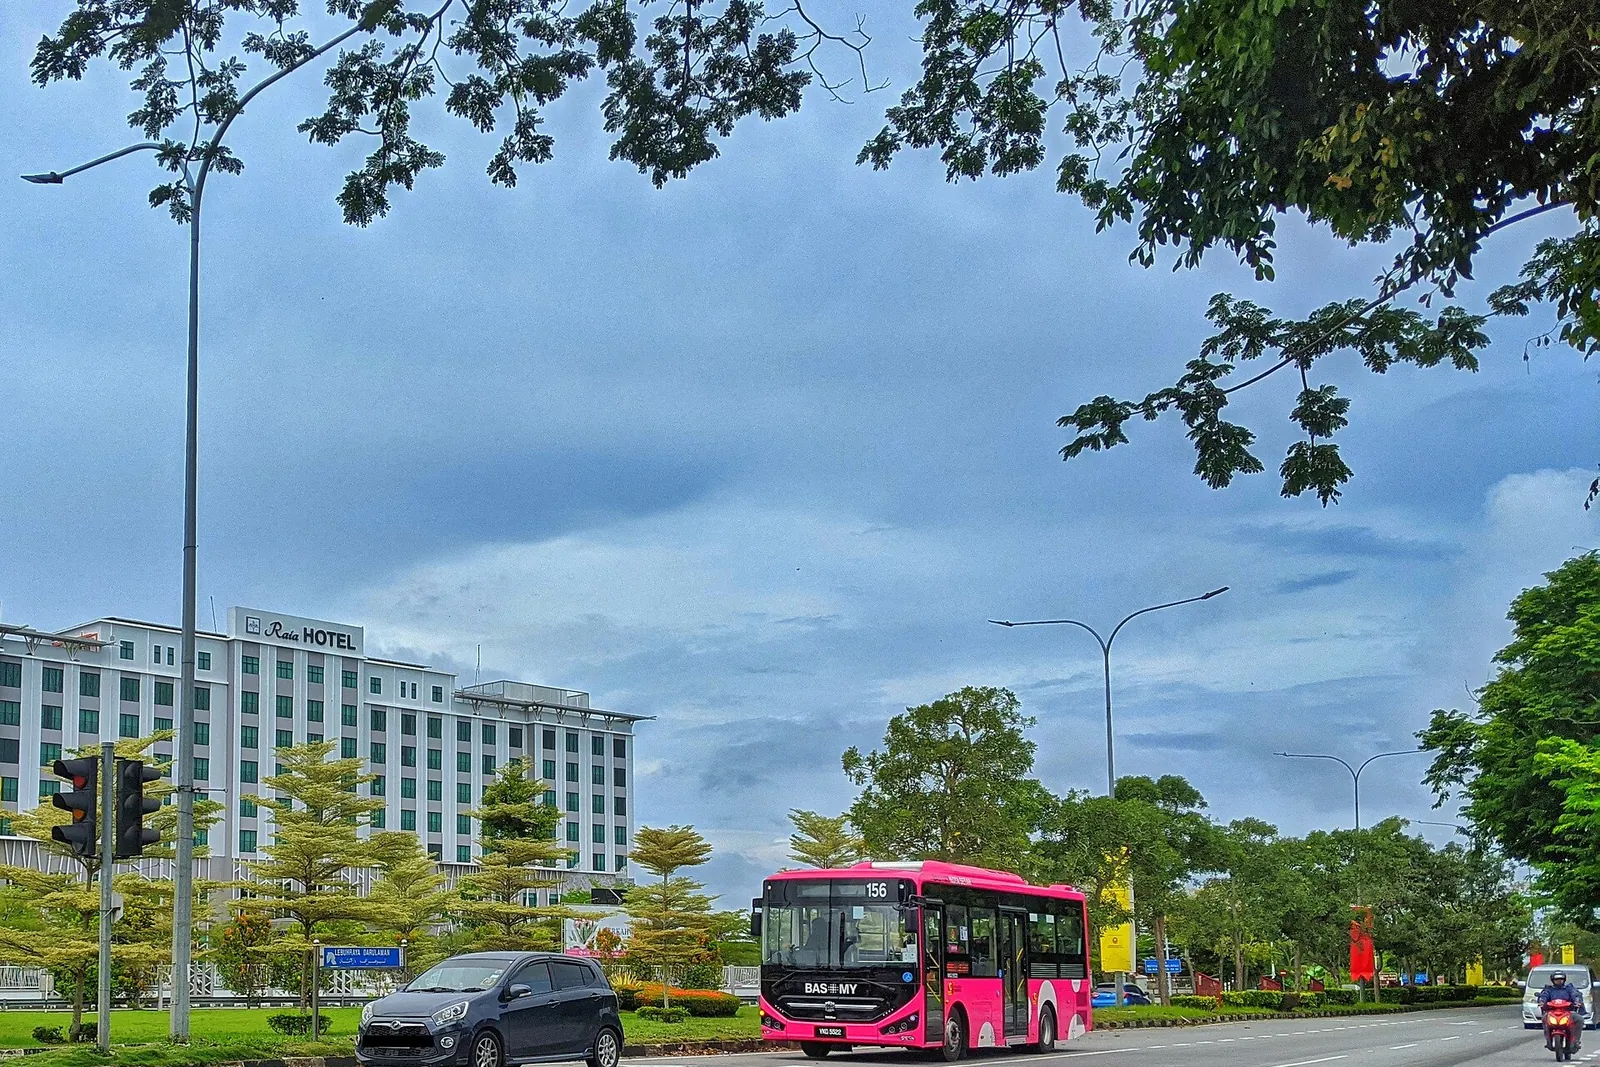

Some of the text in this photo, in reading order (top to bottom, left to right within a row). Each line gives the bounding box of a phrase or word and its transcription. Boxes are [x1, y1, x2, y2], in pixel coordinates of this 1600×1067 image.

[264, 621, 356, 650] Raia HOTEL
[866, 882, 887, 898] 156
[334, 948, 390, 956] LEBUHRAYA DARULAMAN
